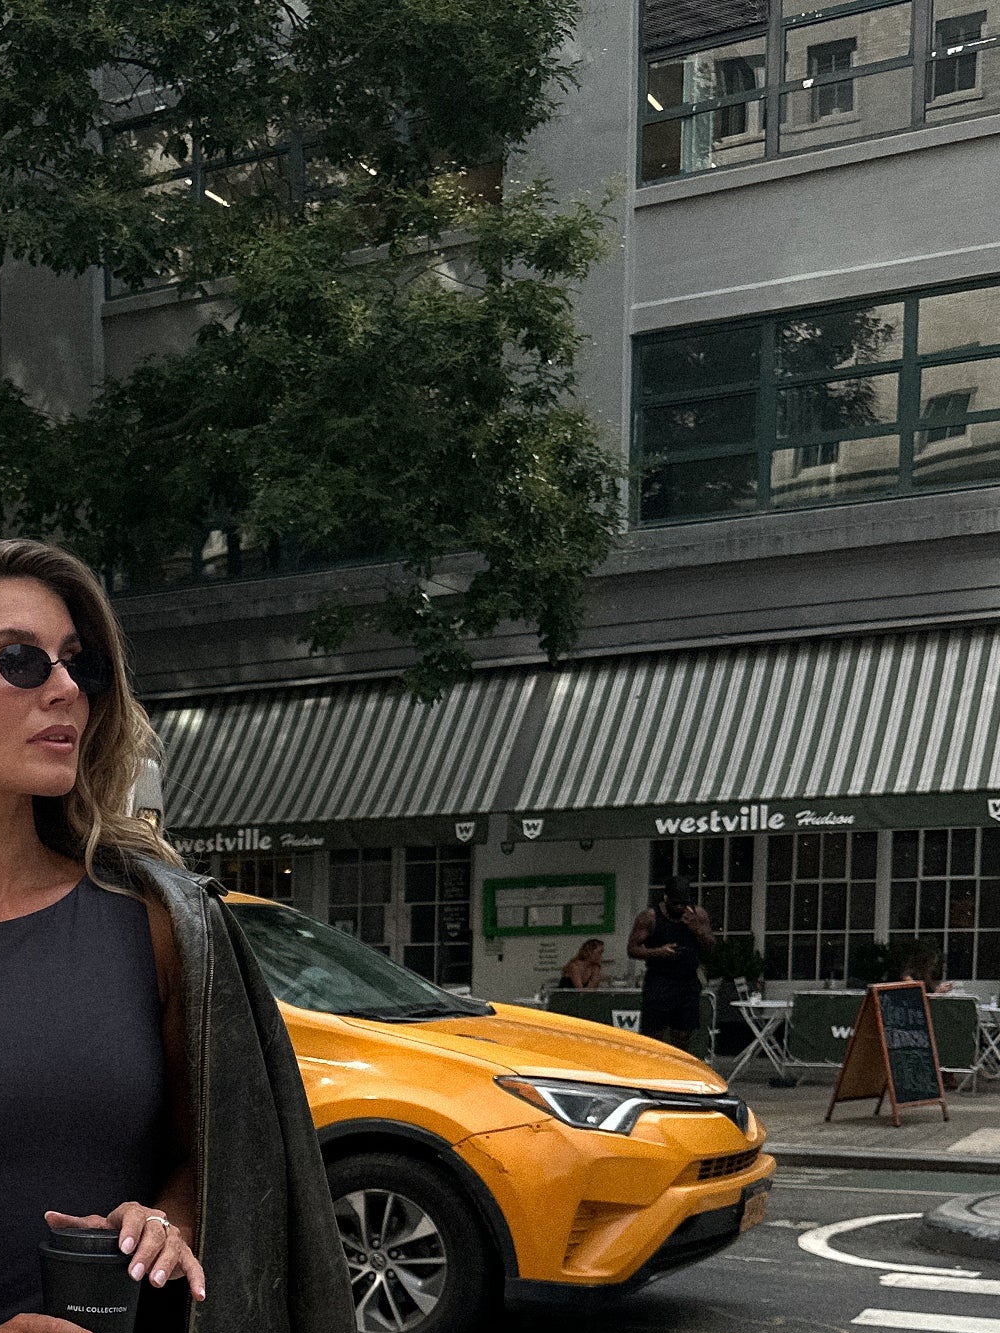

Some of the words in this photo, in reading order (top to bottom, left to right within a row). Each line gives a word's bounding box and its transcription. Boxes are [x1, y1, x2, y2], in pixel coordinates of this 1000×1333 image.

[655, 805, 785, 834] westville
[795, 810, 855, 825] Hudson
[174, 828, 272, 852] westville
[66, 1304, 85, 1312] MULI
[86, 1306, 128, 1314] COLLECTION
